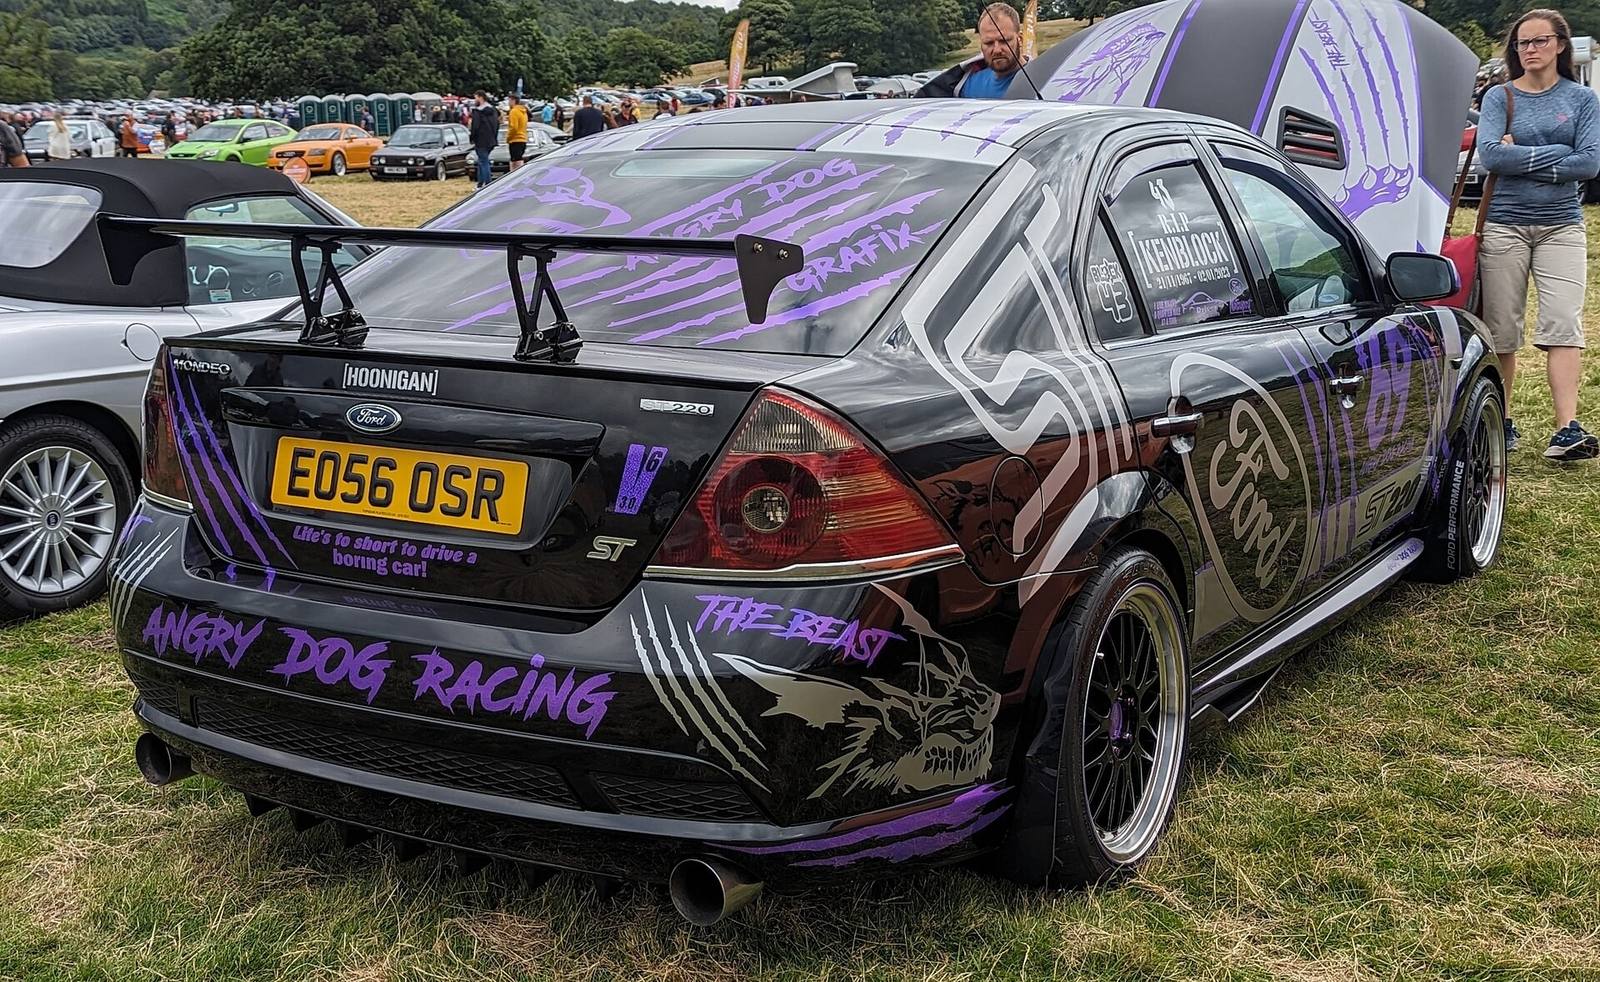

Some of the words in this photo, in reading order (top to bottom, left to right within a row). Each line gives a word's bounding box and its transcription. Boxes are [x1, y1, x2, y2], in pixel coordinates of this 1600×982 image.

[748, 157, 858, 208] DOG
[1097, 281, 1133, 324] 43
[172, 358, 231, 376] MONDEO
[354, 407, 388, 427] Ford
[287, 446, 397, 508] EO56
[408, 460, 505, 522] OSR
[1448, 459, 1466, 541] PERFORMANCE
[292, 524, 332, 546] Life's
[335, 532, 350, 549] to
[354, 535, 398, 554] short
[401, 541, 417, 557] to
[421, 543, 464, 564] drive
[466, 550, 479, 565] a
[332, 549, 389, 576] boring
[392, 560, 427, 578] car!
[587, 535, 638, 562] ST
[1447, 538, 1458, 570] FORD
[694, 594, 788, 636] THE
[770, 607, 907, 668] BEAST
[141, 600, 268, 669] ANGRY
[265, 626, 396, 705] DOG
